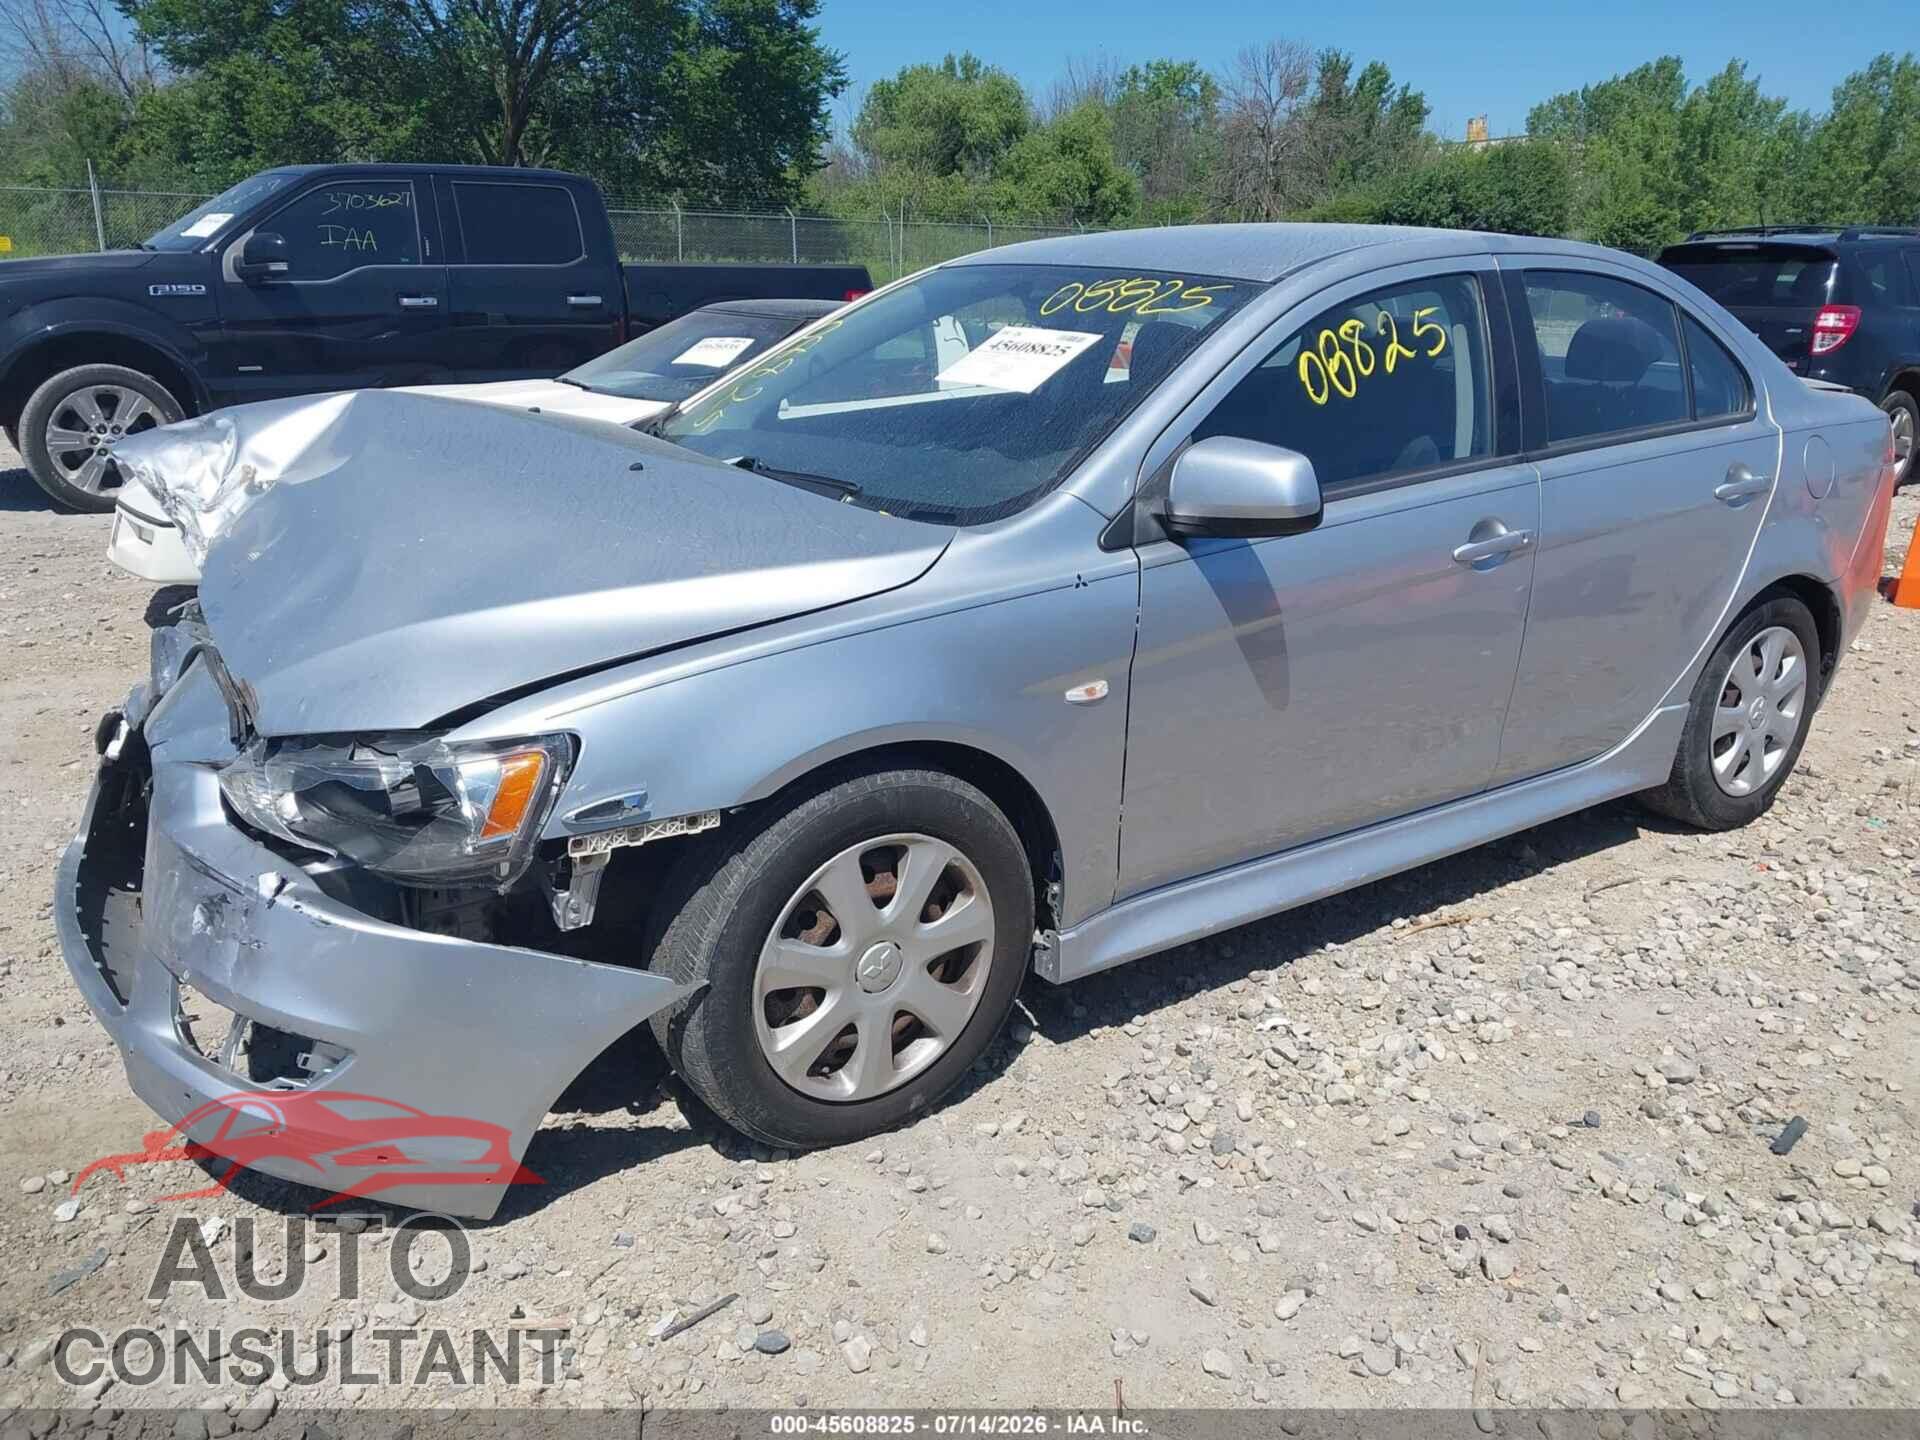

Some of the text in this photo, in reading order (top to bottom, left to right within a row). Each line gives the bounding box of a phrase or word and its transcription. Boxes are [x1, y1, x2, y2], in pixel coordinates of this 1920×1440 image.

[317, 224, 377, 251] IAA
[1040, 277, 1234, 316] 08825
[1298, 306, 1447, 405] 08825
